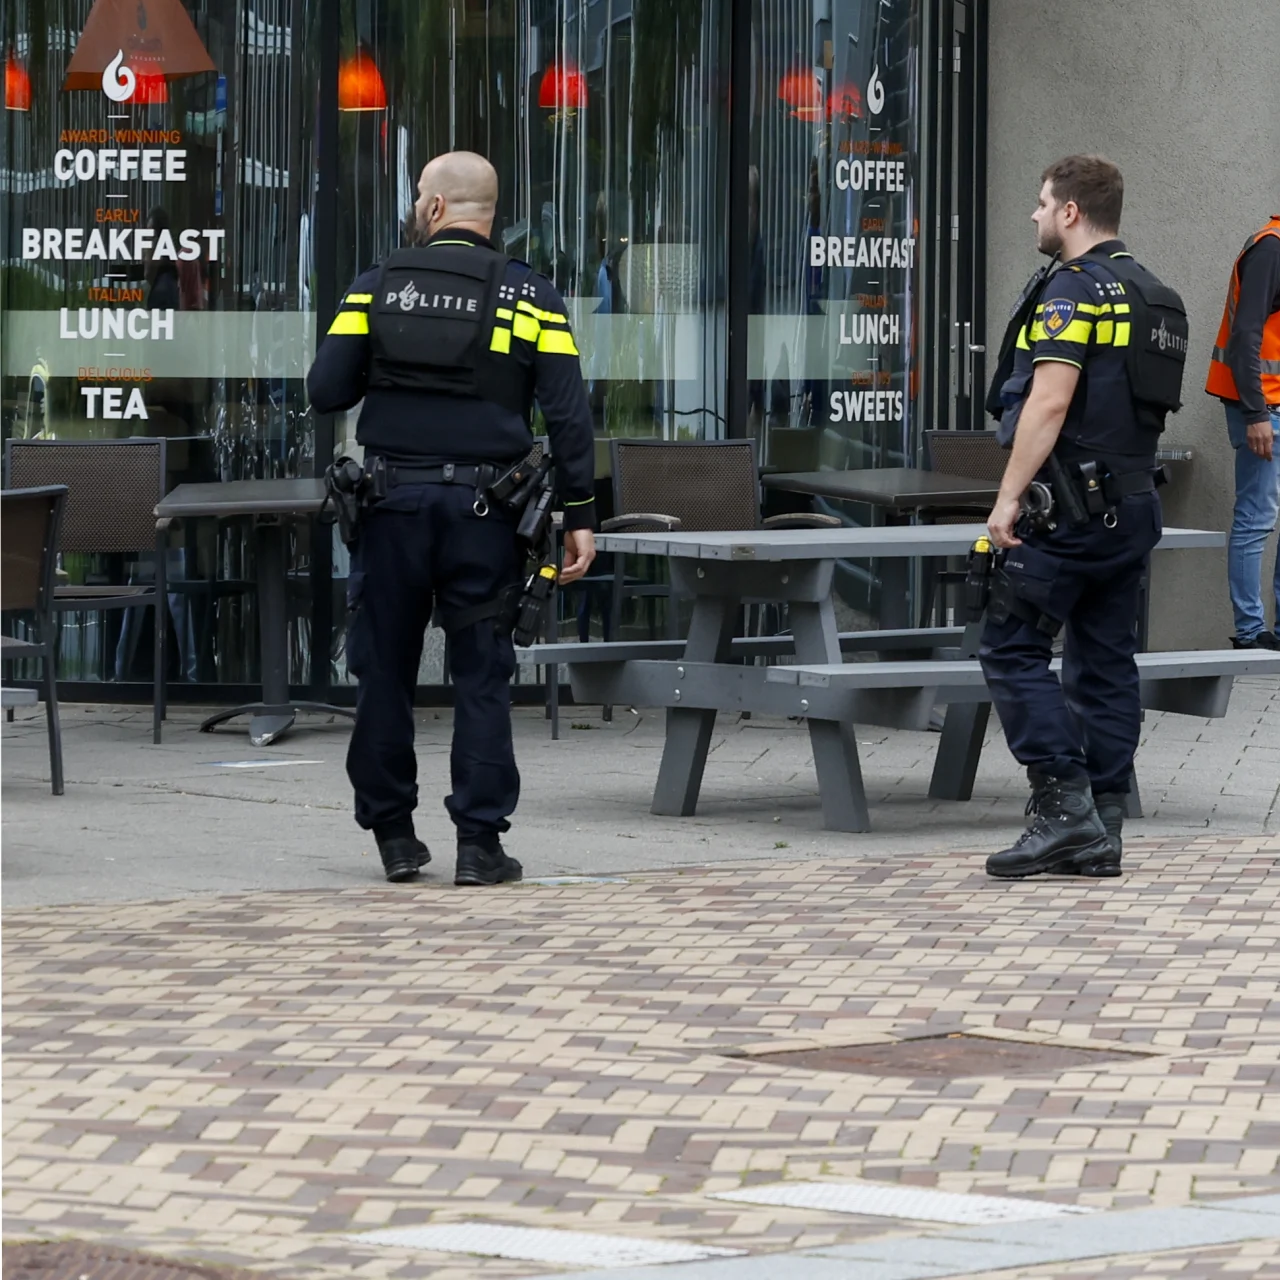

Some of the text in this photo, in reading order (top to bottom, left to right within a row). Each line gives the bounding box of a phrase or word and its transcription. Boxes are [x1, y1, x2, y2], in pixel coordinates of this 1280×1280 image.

[60, 129, 181, 144] AWARD-WINNING
[54, 149, 187, 181] COFFEE
[836, 159, 905, 192] COFFEE
[96, 208, 139, 223] EARLY
[22, 228, 225, 261] BREAKFAST
[810, 235, 916, 269] BREAKFAST
[88, 287, 143, 303] ITALIAN
[60, 307, 174, 340] LUNCH
[839, 313, 900, 345] LUNCH
[78, 366, 152, 382] DELICIOUS
[81, 387, 148, 420] TEA
[829, 390, 904, 422] SWEETS
